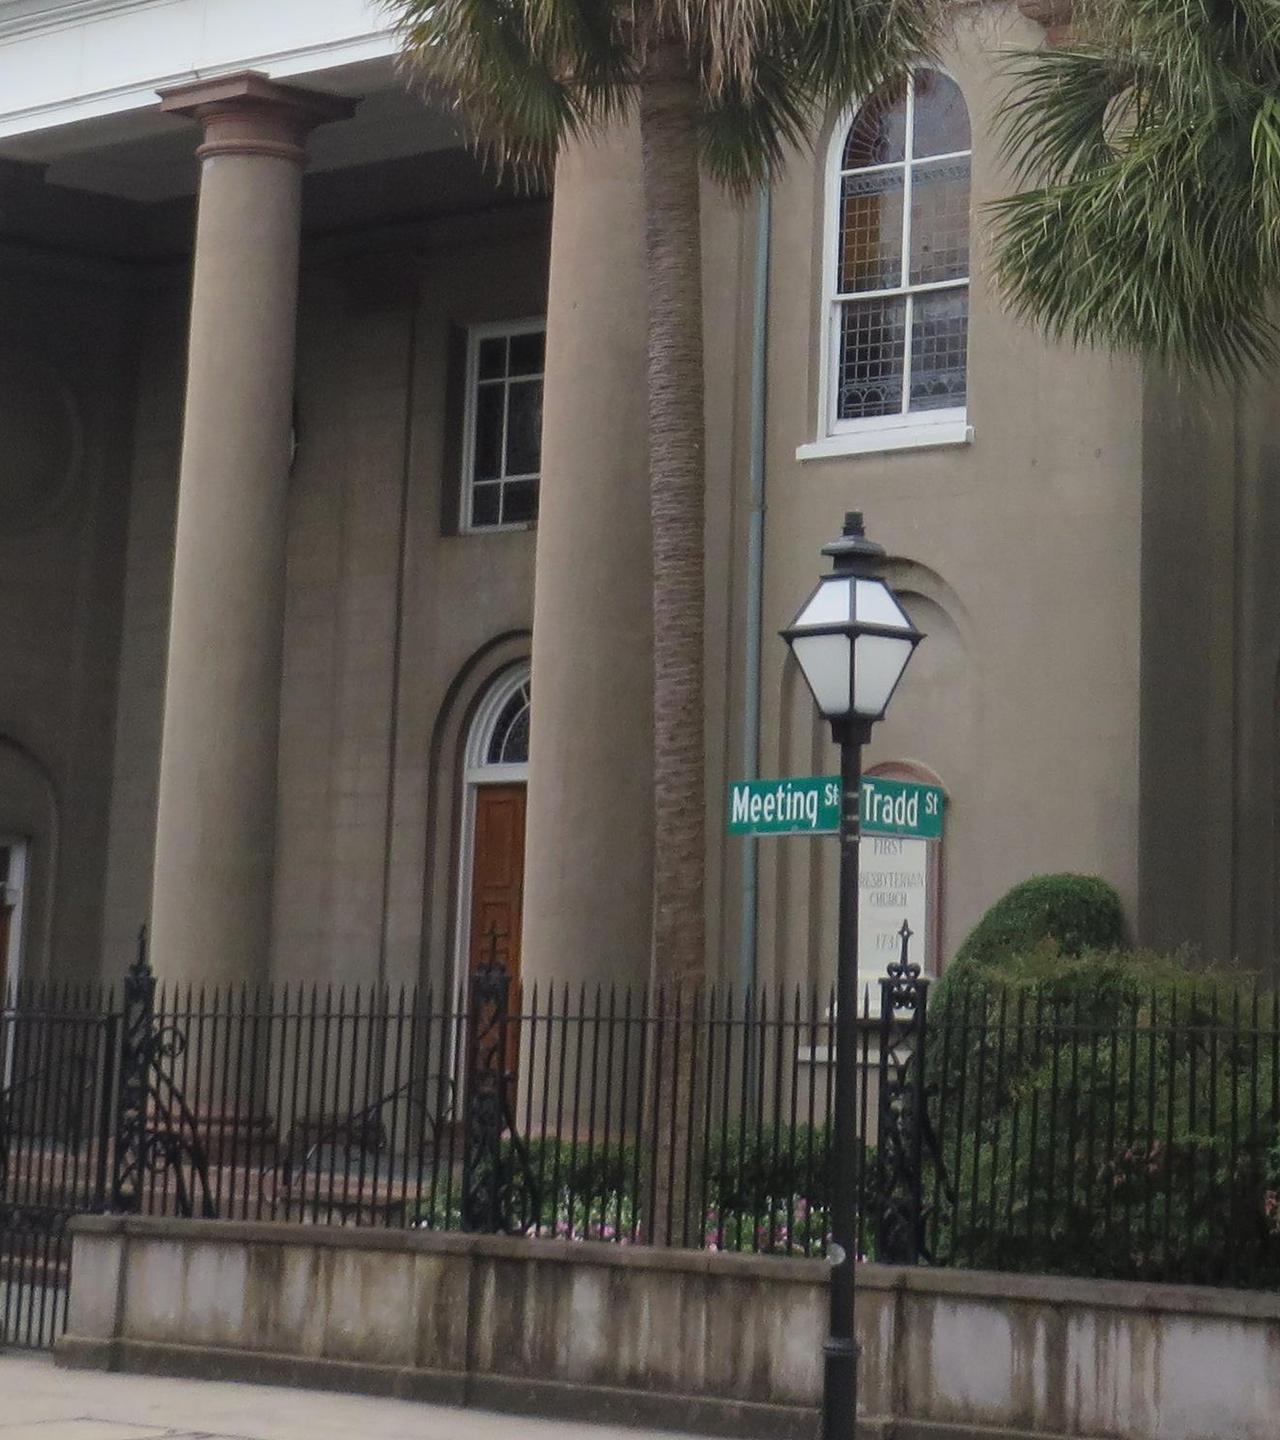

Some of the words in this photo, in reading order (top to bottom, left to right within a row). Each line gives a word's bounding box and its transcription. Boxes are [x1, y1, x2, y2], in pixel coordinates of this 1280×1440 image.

[731, 783, 818, 828] Meeting
[824, 783, 839, 806] St
[862, 783, 919, 827] Tradd
[924, 791, 939, 815] St
[873, 838, 903, 855] FIRST
[859, 871, 925, 889] RESBYTERIAN
[869, 890, 908, 907] CHURCH
